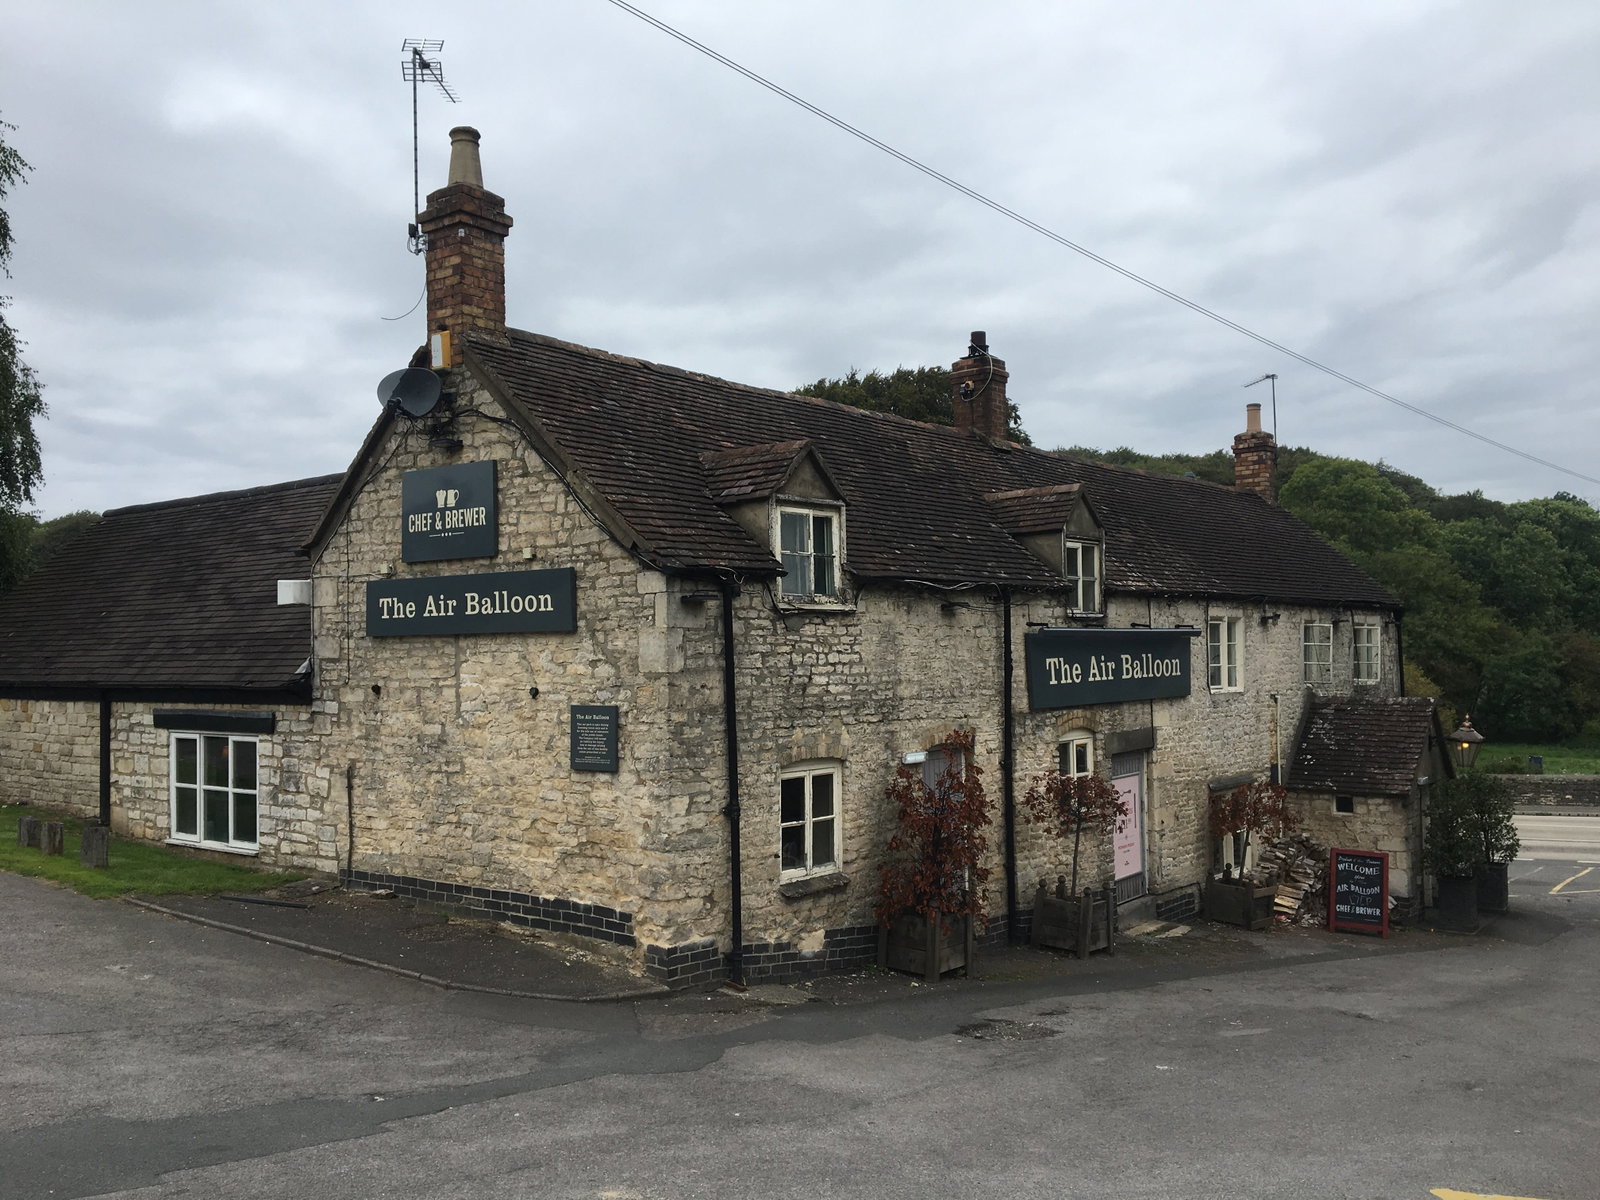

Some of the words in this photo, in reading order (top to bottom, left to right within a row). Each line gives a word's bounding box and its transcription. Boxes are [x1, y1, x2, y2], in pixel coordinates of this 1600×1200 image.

[408, 511, 432, 533] CHEF
[435, 511, 442, 530] &
[445, 506, 486, 529] BREWER
[379, 597, 416, 620] The
[423, 594, 456, 617] Air
[464, 590, 553, 615] Balloon
[1046, 658, 1082, 684] The
[1088, 655, 1116, 682] Air
[1120, 654, 1181, 679] Balloon
[1337, 862, 1380, 875] WELCOME
[1336, 884, 1349, 893] AIR
[1350, 884, 1380, 896] BALLOON
[1336, 904, 1350, 913] CHEF
[1355, 907, 1381, 916] BREWER
